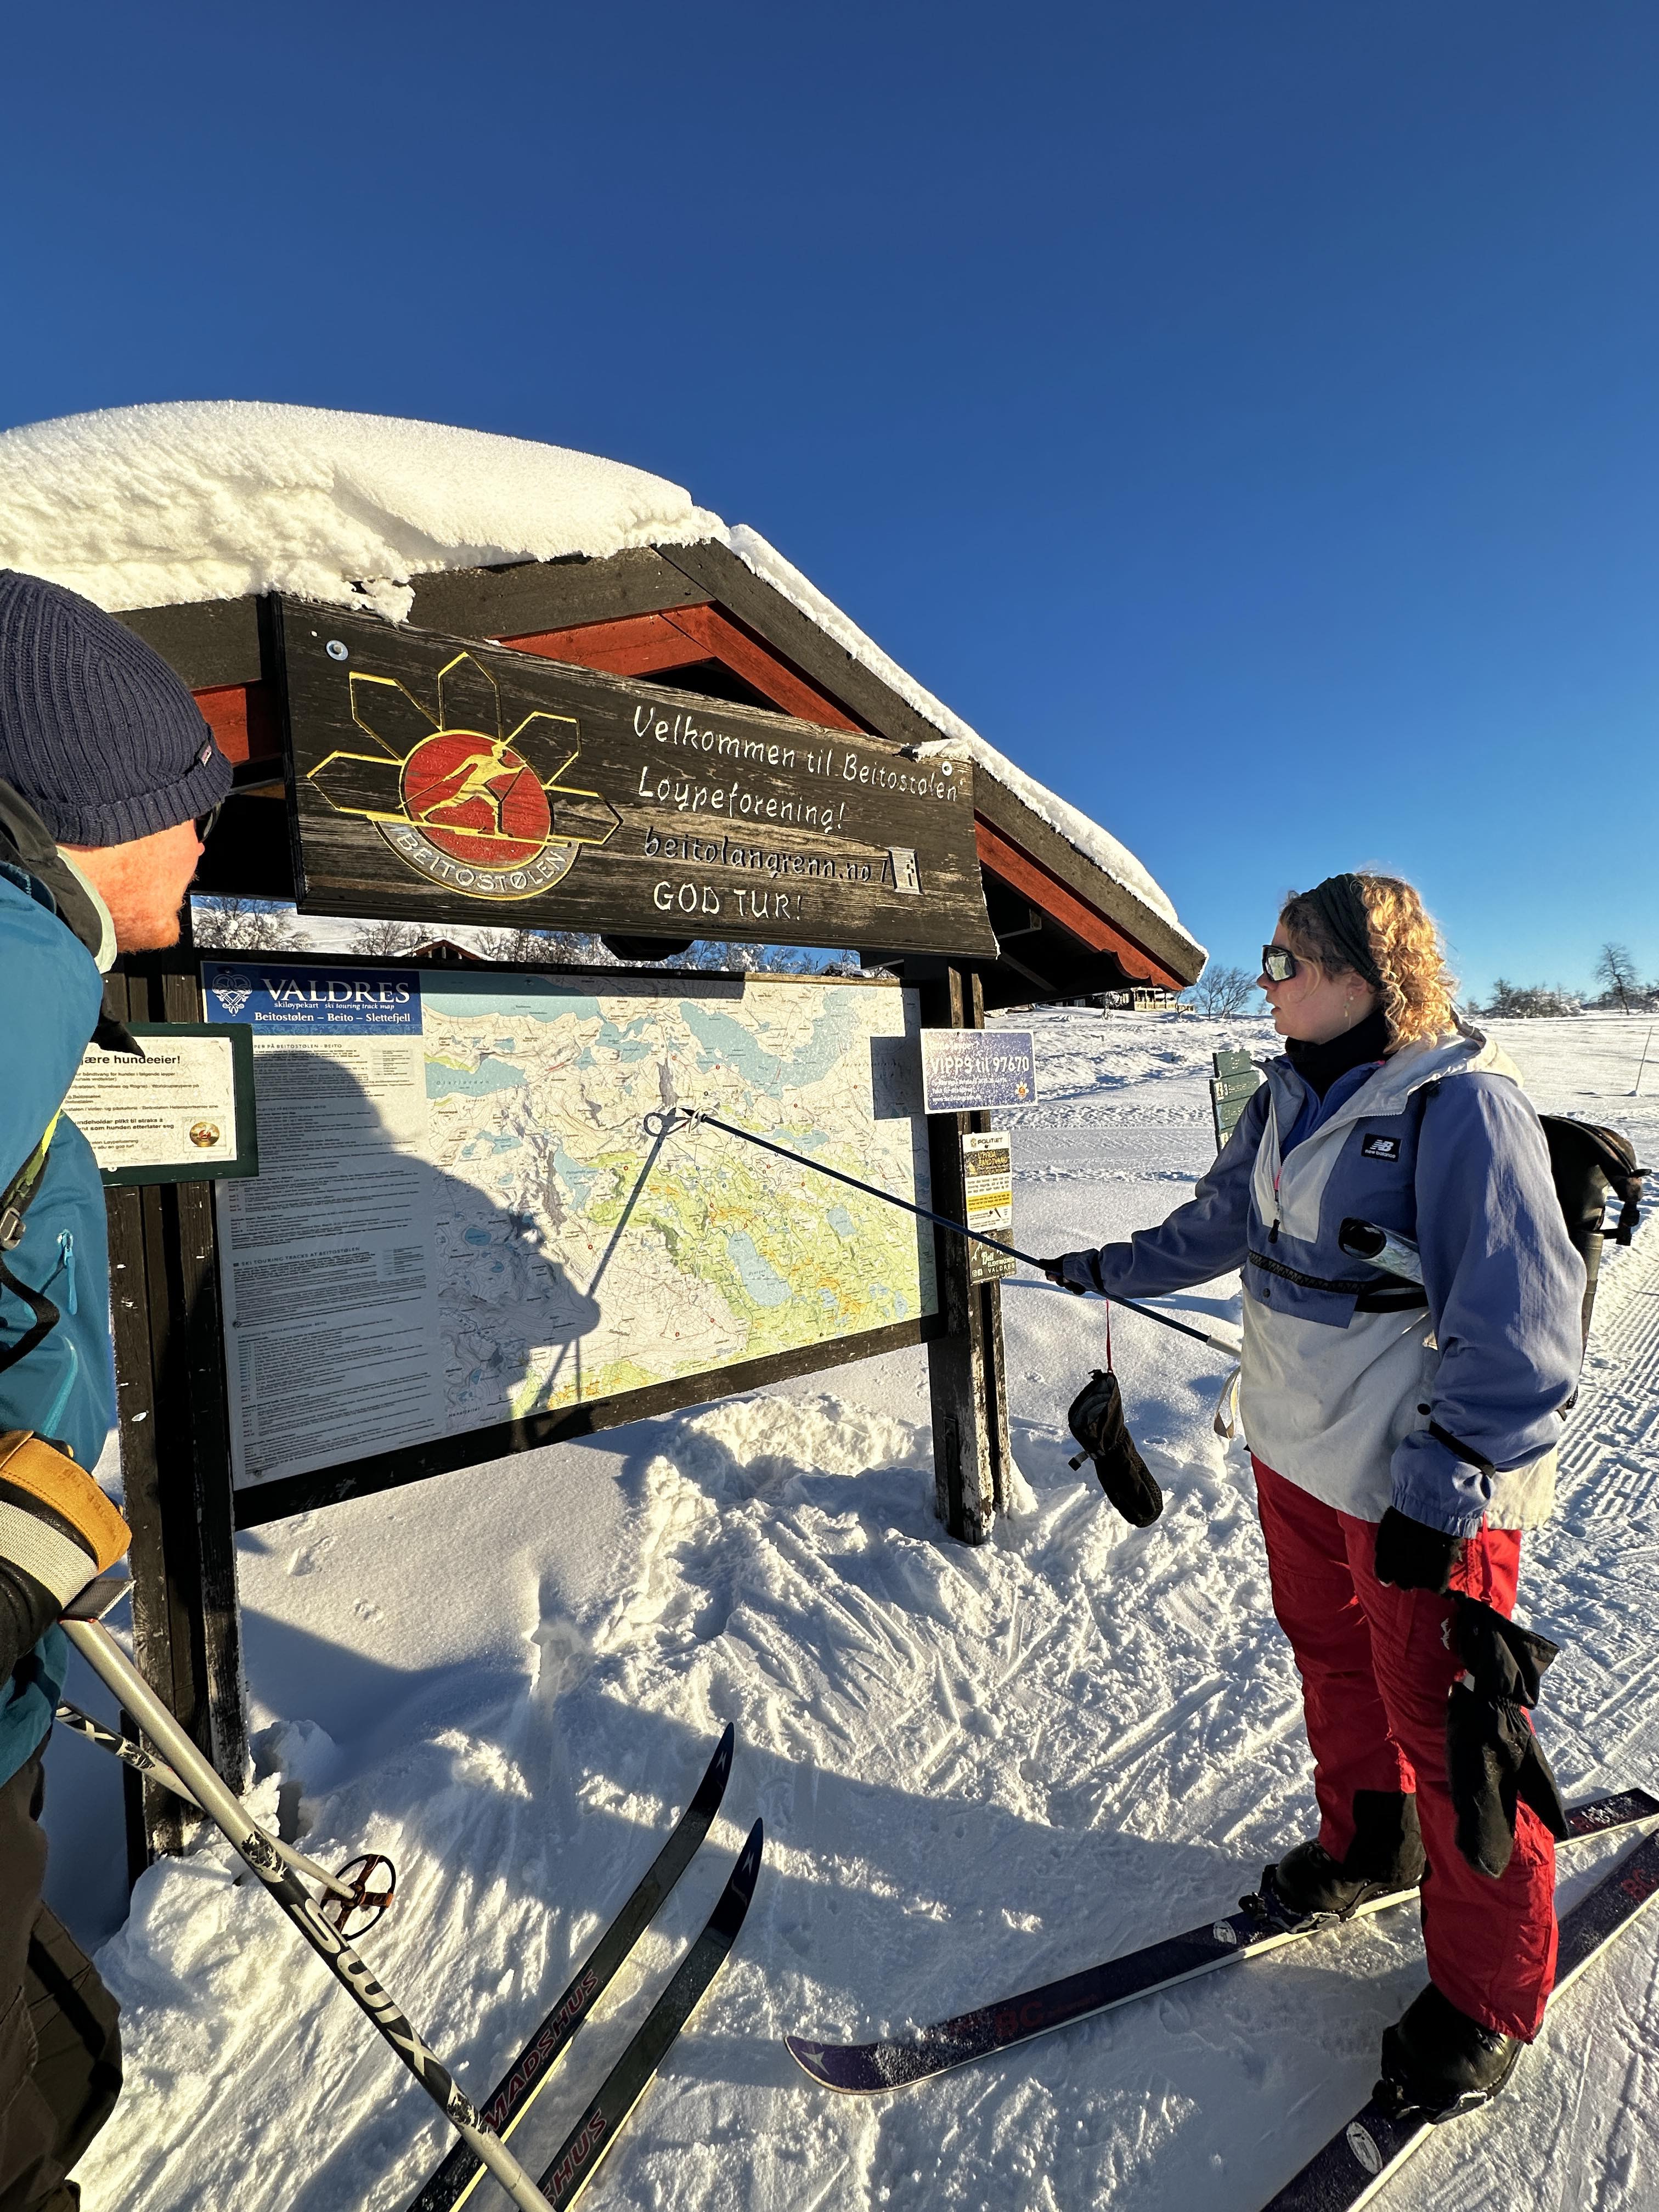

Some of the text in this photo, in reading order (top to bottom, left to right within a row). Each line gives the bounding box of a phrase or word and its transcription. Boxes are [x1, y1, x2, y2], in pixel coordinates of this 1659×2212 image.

[633, 705, 796, 769] Velkommen
[806, 748, 832, 776] til
[397, 832, 566, 891] BEITOSTØLEN
[644, 826, 872, 879] beitolangrenn.no
[654, 880, 803, 921] GOD TUR!
[261, 978, 410, 1003] VALDRES
[274, 1002, 319, 1010] skiløypekart
[336, 1002, 360, 1011] touring
[255, 1012, 314, 1022] Beitostølen
[328, 1013, 354, 1022] Beito
[366, 1013, 410, 1024] Slettefjell
[81, 1057, 110, 1065] jære
[992, 1056, 1030, 1073] 97670
[1376, 1150, 1396, 1159] balance
[254, 1256, 284, 1265] TOURING
[319, 1246, 360, 1256] BEITOSTØLEN
[988, 1263, 1015, 1274] VALDRES
[482, 1968, 599, 2131] MADSHUS
[542, 2107, 607, 2207] SHUS
